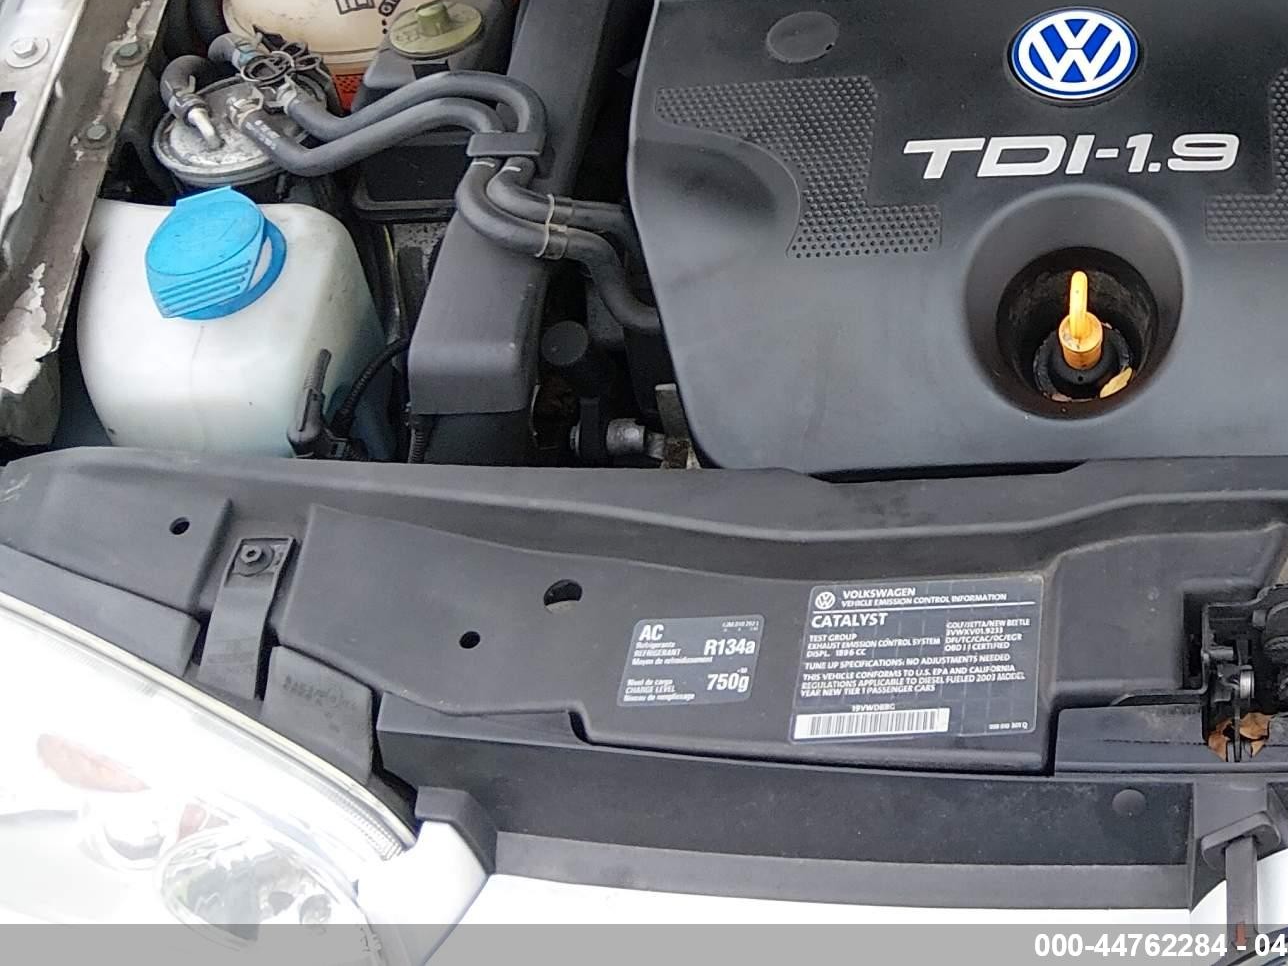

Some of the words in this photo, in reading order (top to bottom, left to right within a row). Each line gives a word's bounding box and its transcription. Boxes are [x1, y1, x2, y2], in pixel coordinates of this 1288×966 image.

[903, 134, 1239, 179] TDI-1.9
[843, 587, 916, 599] VOLKSWAGEN
[841, 600, 873, 608] VEHICLE
[874, 598, 912, 606] EMISSION
[914, 596, 950, 604] CONTROL
[951, 594, 1007, 602] INFORMATION
[811, 613, 888, 629] CATALYST
[638, 625, 664, 641] AC
[828, 634, 857, 642] GROUP
[703, 638, 756, 655] R134a
[841, 641, 877, 649] EMISSION
[912, 637, 941, 645] SYSTEM
[804, 662, 826, 670] TUNE
[920, 656, 977, 664] ADJUSTMENTS
[979, 654, 1010, 662] NEEDED
[822, 672, 854, 680] VEHICLE
[855, 670, 902, 679] CONFORMS
[969, 665, 1015, 673] CALIFORNIA
[706, 673, 749, 692] 750g
[802, 681, 857, 690] REGULATIONS
[858, 679, 904, 687] APPLICABLE
[945, 675, 975, 683] FUELED
[801, 689, 821, 697] YEAR
[822, 688, 841, 696] NEW
[843, 687, 862, 695] TIER
[866, 685, 912, 694] PASSENGER
[914, 684, 935, 692] CARS
